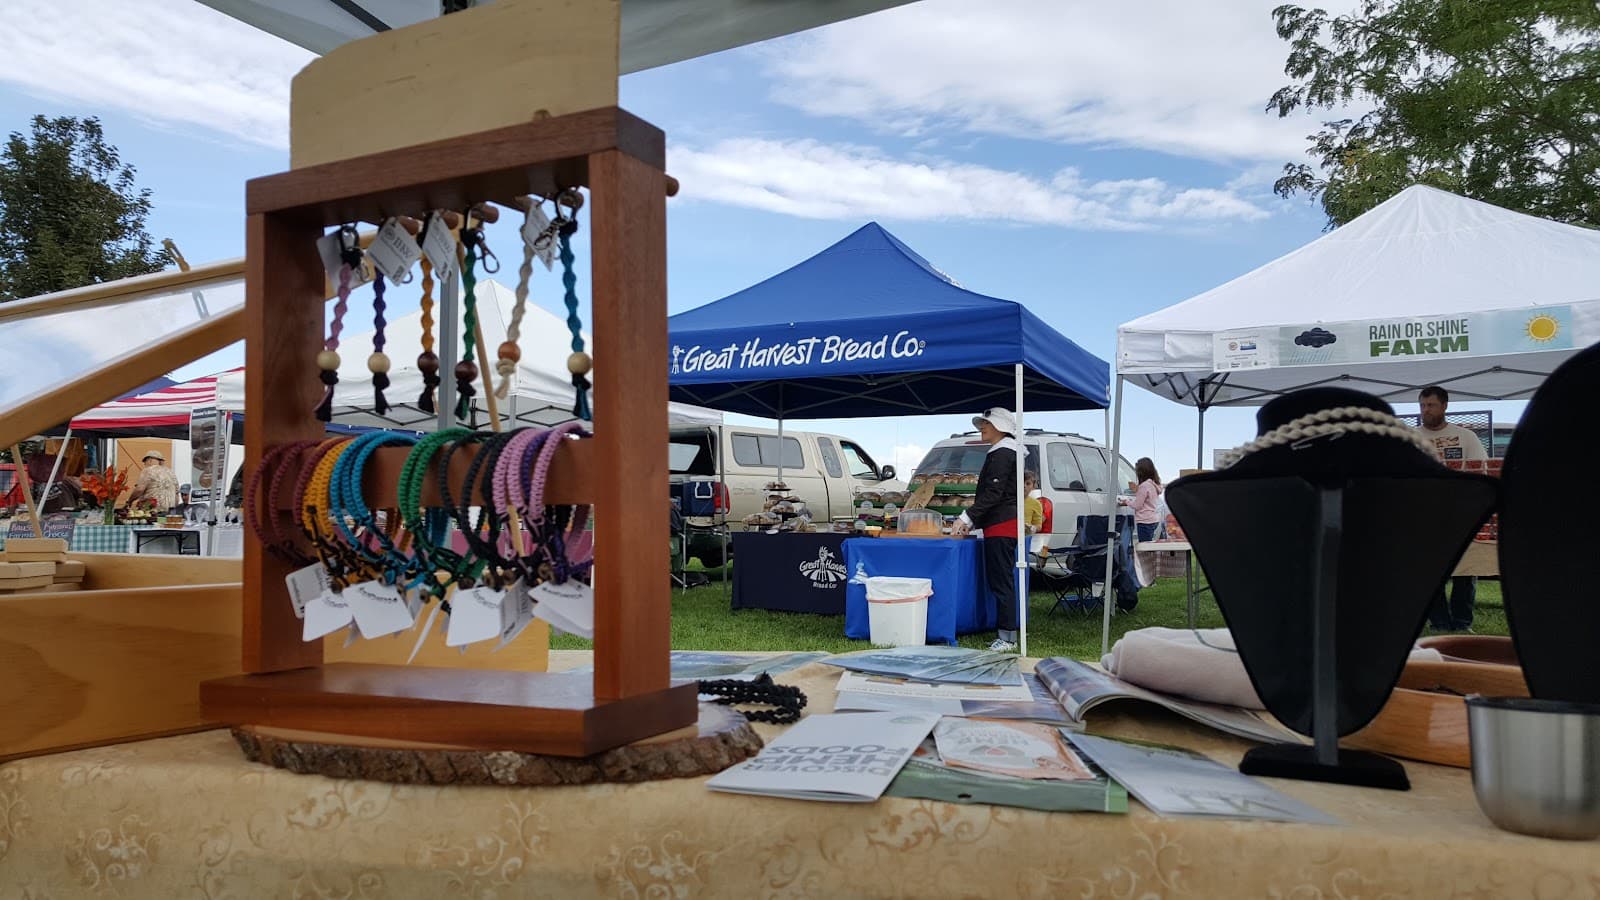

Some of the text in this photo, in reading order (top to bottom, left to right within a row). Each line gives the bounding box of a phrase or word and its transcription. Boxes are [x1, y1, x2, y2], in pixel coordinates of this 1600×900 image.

[1369, 319, 1469, 340] RAIN OR SHINE
[682, 343, 739, 373] Great
[740, 337, 820, 368] Harvest
[821, 334, 889, 363] Bread
[1370, 335, 1469, 357] FARM
[799, 559, 847, 574] Great Harves
[765, 744, 909, 755] FOODS
[753, 754, 901, 767] HEMP
[743, 764, 892, 777] DISCOVER
